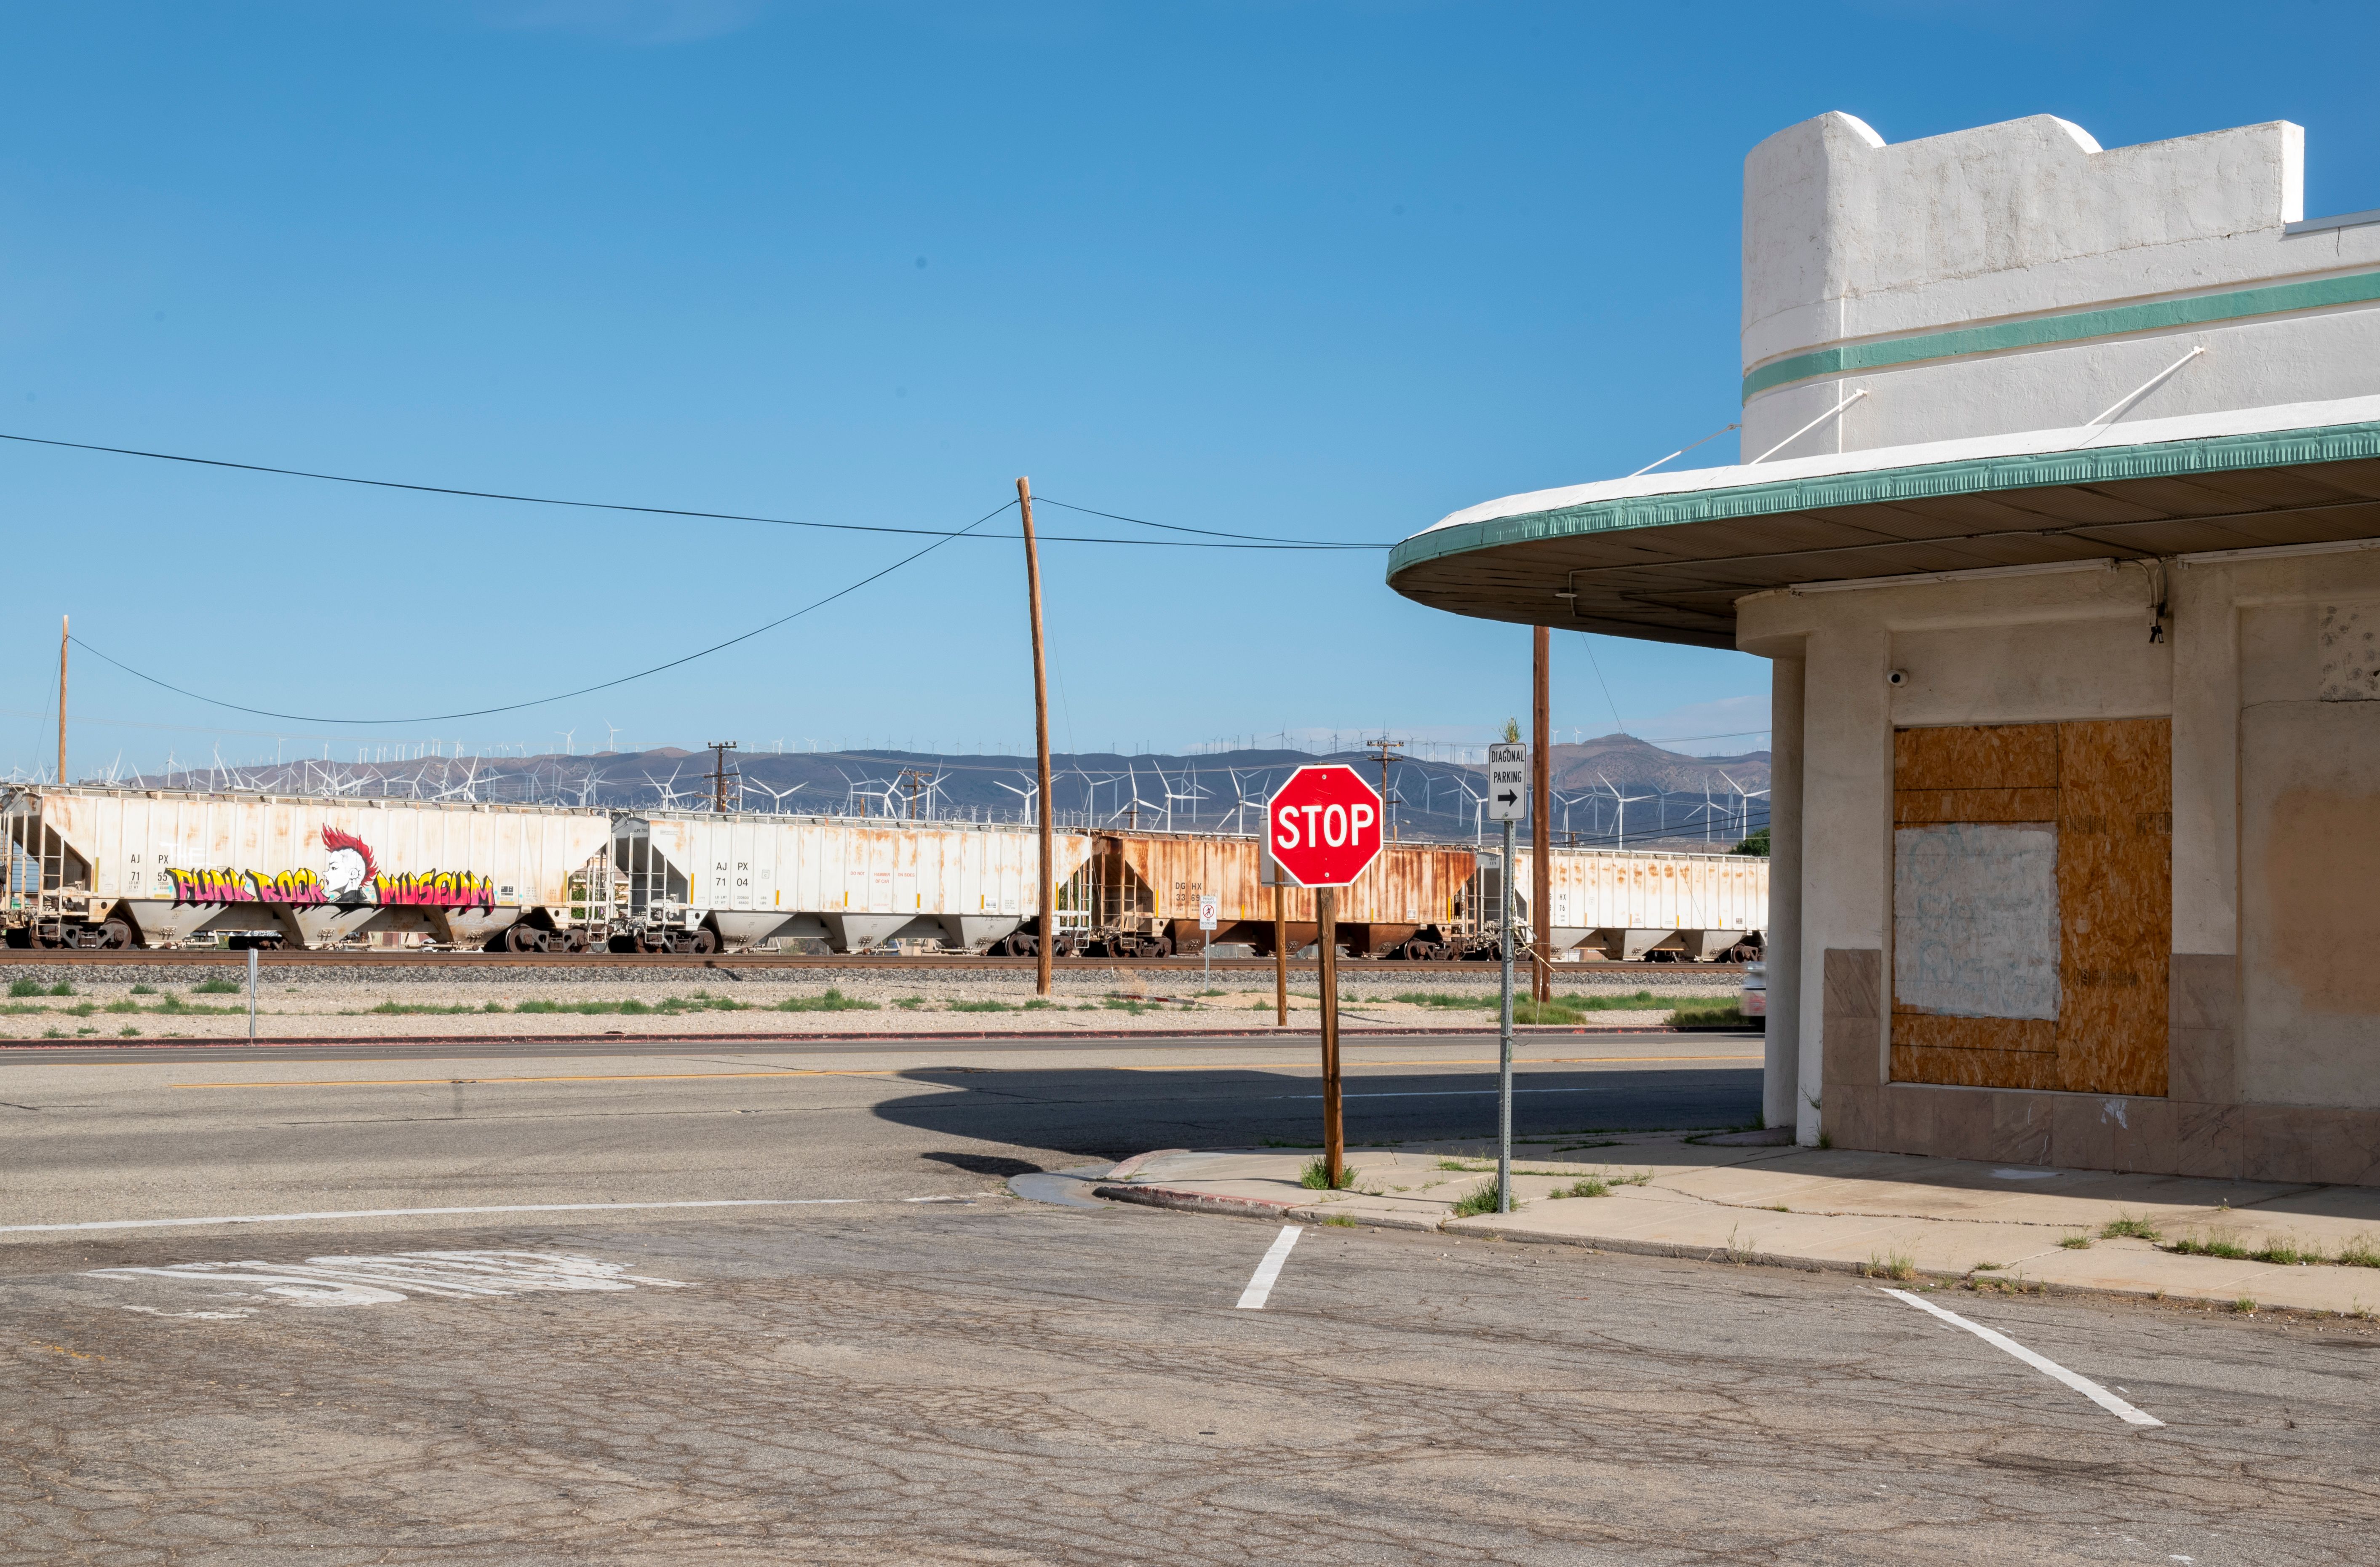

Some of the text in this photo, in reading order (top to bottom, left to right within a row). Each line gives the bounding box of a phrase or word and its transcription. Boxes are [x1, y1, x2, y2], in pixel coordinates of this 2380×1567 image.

[1491, 750, 1525, 763] DIAGONAL
[1493, 771, 1522, 783] PARKING
[1277, 804, 1374, 849] STOP
[131, 854, 168, 864] AJ PX
[716, 862, 748, 870] AJ PX
[131, 872, 167, 881] 71 55
[716, 878, 748, 886] 71 04
[165, 867, 495, 918] PUNK ROCK MUSEUM
